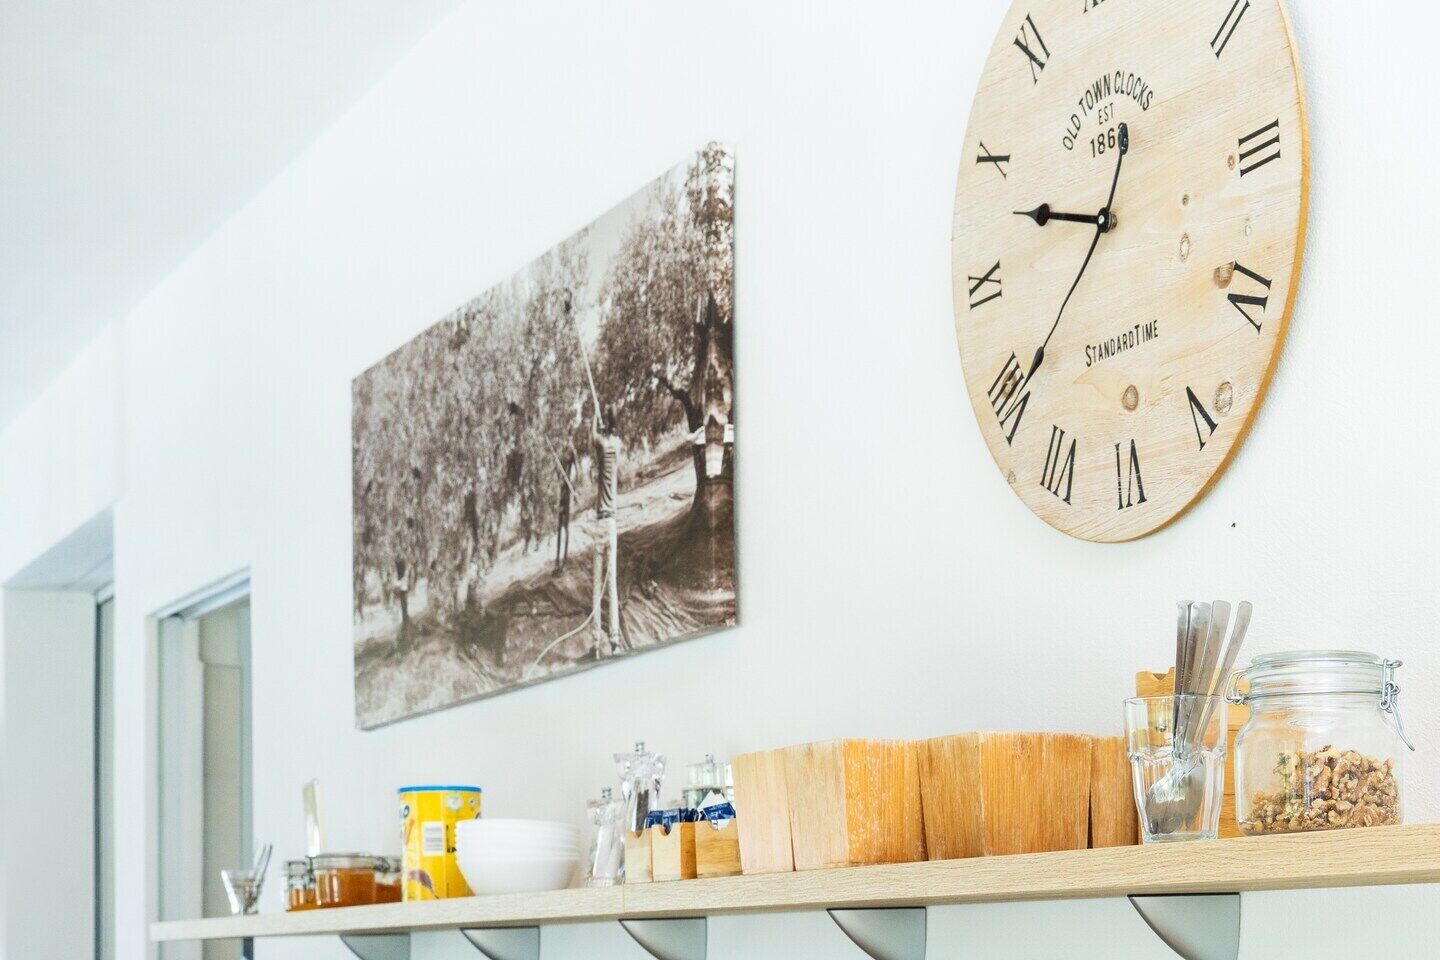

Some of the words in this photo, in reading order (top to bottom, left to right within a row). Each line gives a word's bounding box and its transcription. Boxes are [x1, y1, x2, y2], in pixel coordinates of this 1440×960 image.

[1013, 12, 1051, 84] XI
[1063, 113, 1081, 151] OLD
[1078, 73, 1110, 117] TOWN
[1114, 70, 1153, 112] CLOCKS
[1090, 122, 1128, 158] 186
[1098, 102, 1114, 125] EST
[976, 141, 1011, 180] X
[1238, 118, 1281, 178] III
[1186, 386, 1218, 451] V
